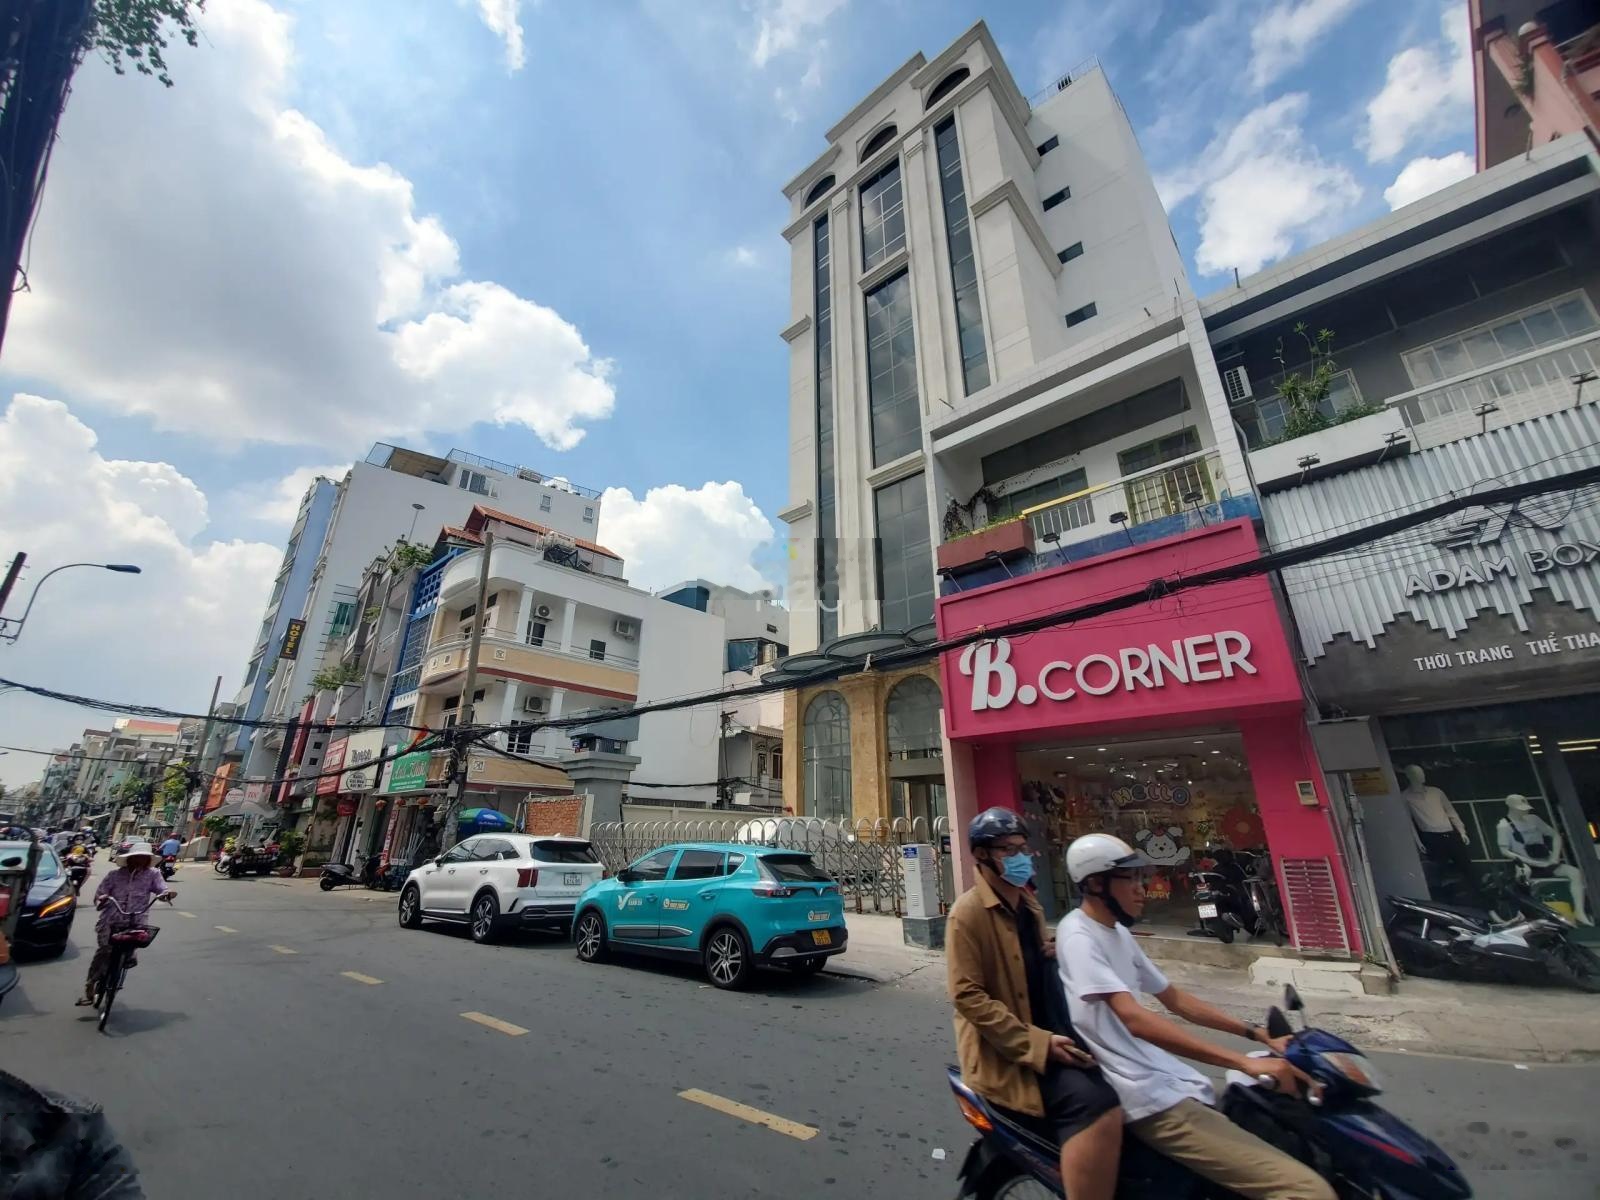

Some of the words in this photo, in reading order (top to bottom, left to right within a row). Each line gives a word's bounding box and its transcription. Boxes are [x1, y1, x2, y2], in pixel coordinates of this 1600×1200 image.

[1405, 555, 1517, 598] ADAM
[1414, 652, 1453, 672] THỜI
[1455, 645, 1514, 667] TRANG
[1526, 632, 1560, 656] THỂ
[1111, 784, 1191, 807] HELLO
